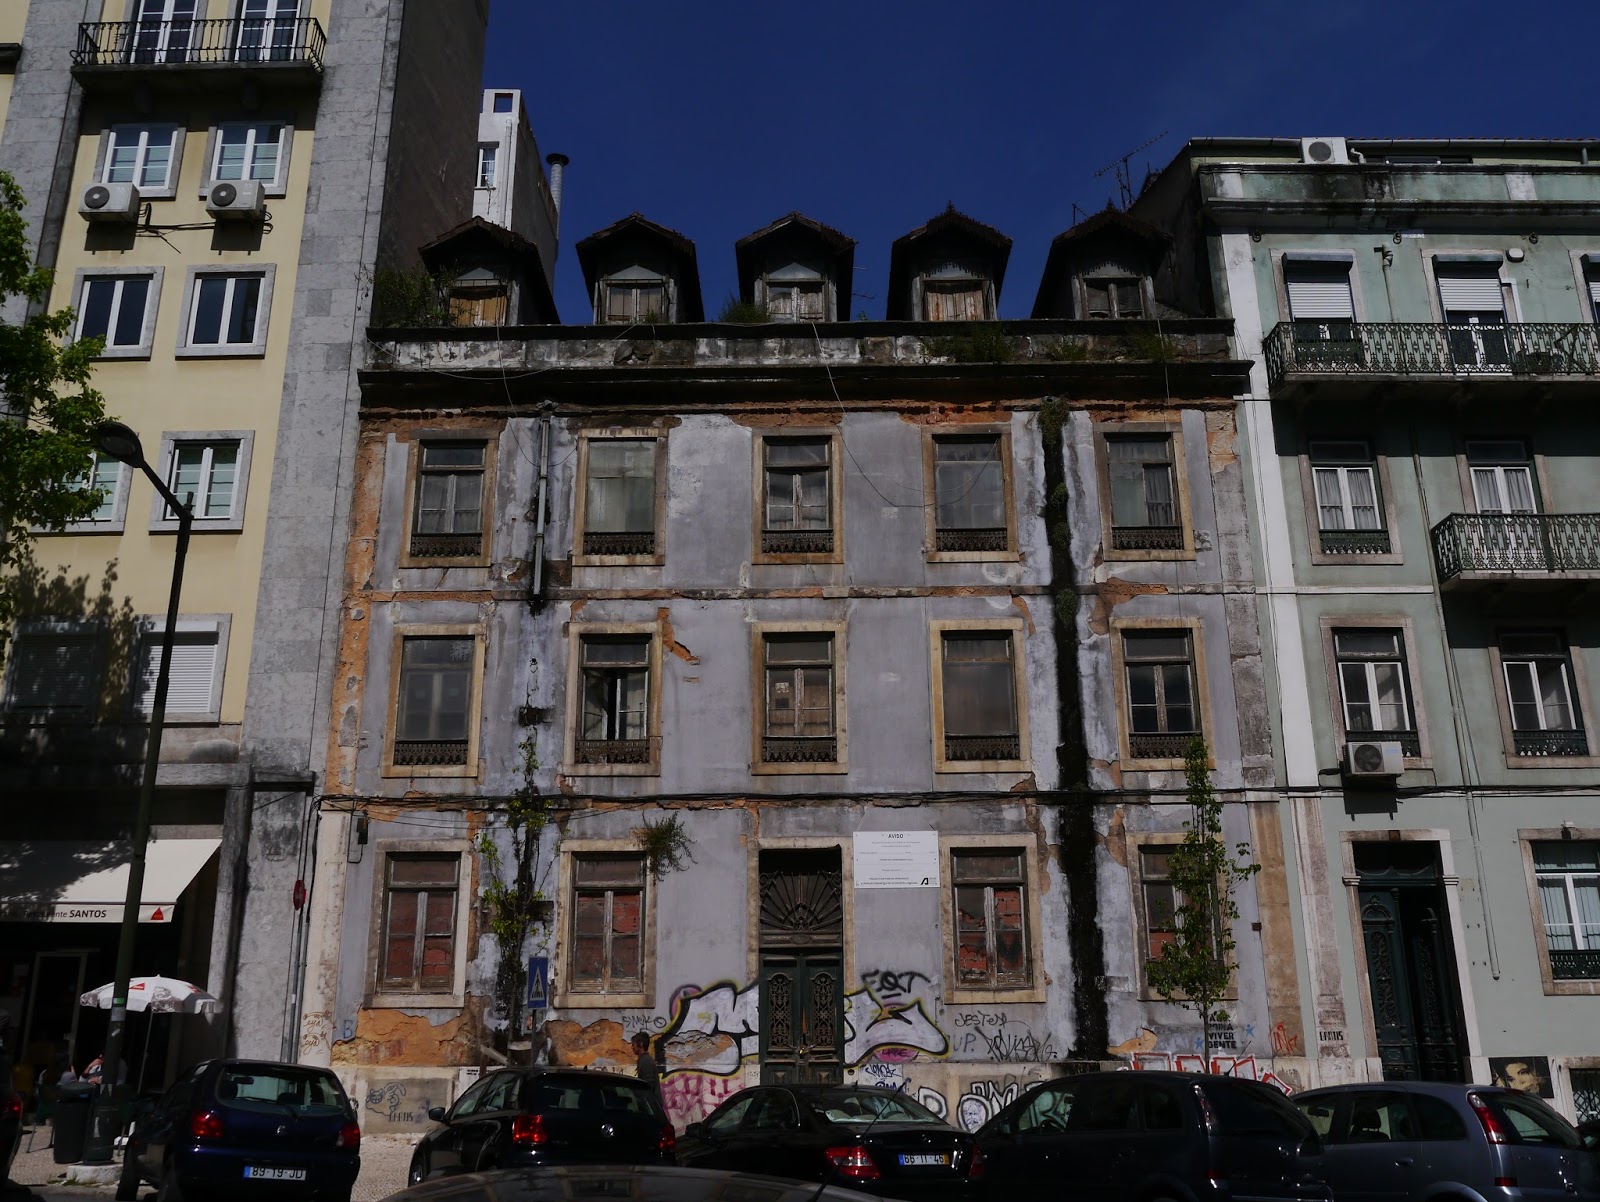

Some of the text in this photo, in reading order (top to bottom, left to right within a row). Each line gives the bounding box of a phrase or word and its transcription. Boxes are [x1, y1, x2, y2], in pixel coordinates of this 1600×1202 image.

[69, 909, 107, 918] SANTOS
[1209, 1032, 1234, 1040] VIVER
[1208, 1041, 1237, 1049] GENTE
